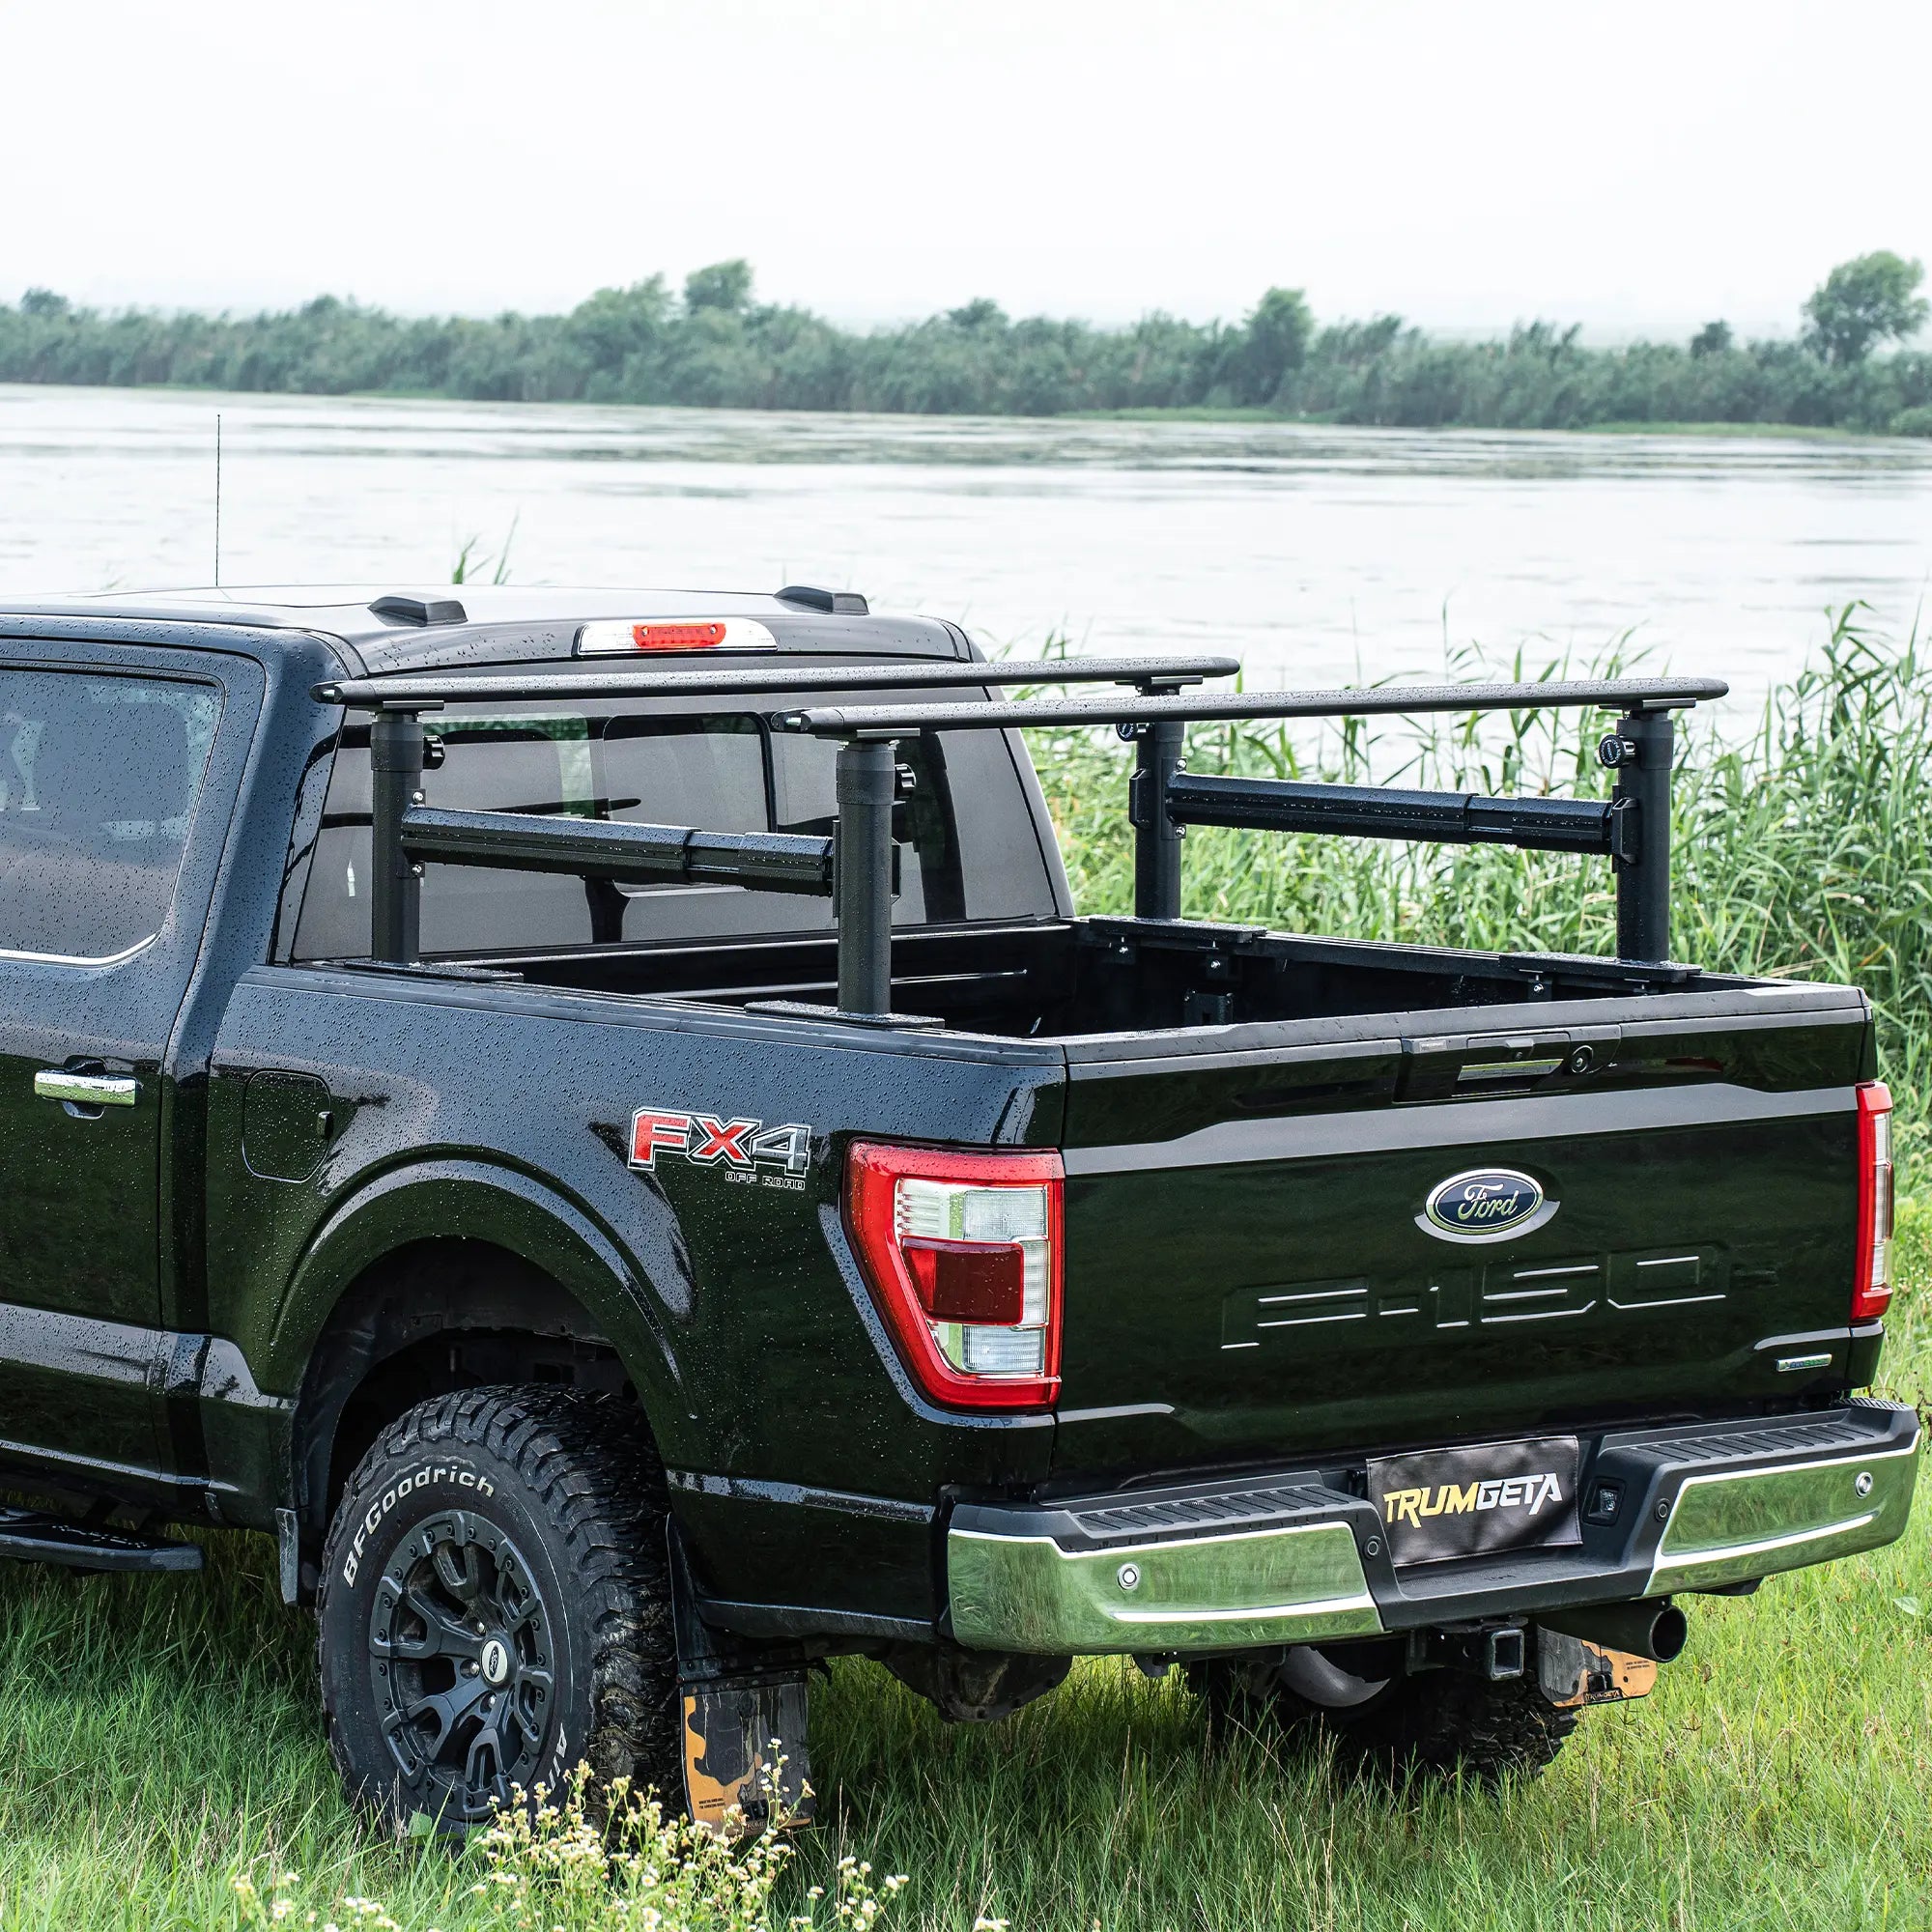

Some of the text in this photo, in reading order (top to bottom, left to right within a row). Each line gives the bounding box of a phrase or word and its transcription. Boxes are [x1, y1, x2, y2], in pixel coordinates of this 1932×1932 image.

[628, 1107, 812, 1178] FX4
[724, 1171, 807, 1191] OFF ROAD
[1458, 1183, 1519, 1220] Ford
[1220, 1240, 1731, 1350] F-150
[343, 1465, 495, 1588] BFGoodrich
[1382, 1473, 1563, 1528] TRUMGETA
